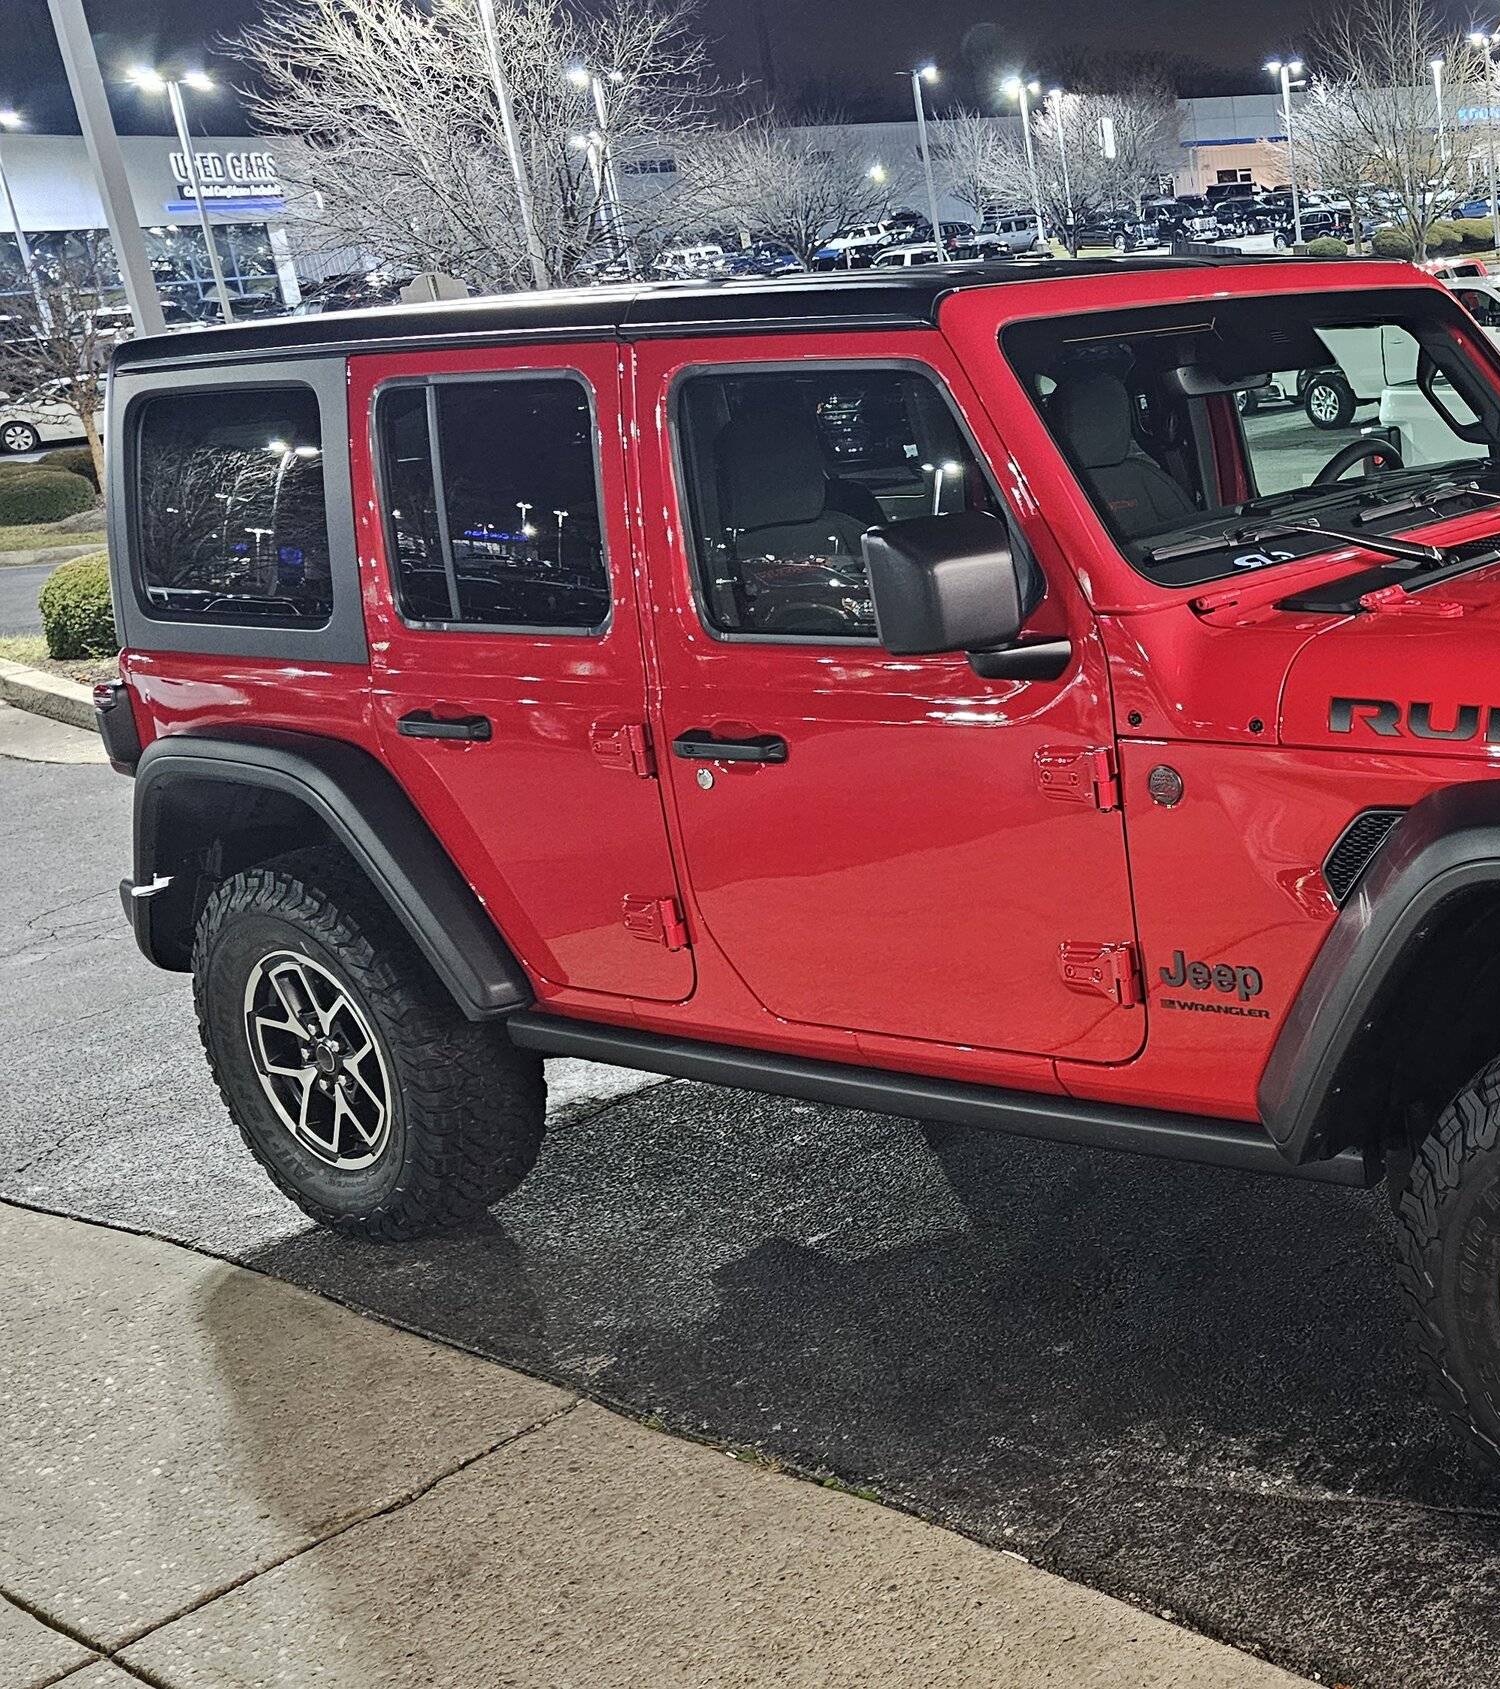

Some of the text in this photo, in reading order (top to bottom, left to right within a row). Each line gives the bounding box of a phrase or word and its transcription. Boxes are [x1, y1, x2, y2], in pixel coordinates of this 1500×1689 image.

[169, 152, 279, 182] UED CARS
[1159, 949, 1263, 1001] Jeep
[1176, 1000, 1270, 1019] WRANGLER
